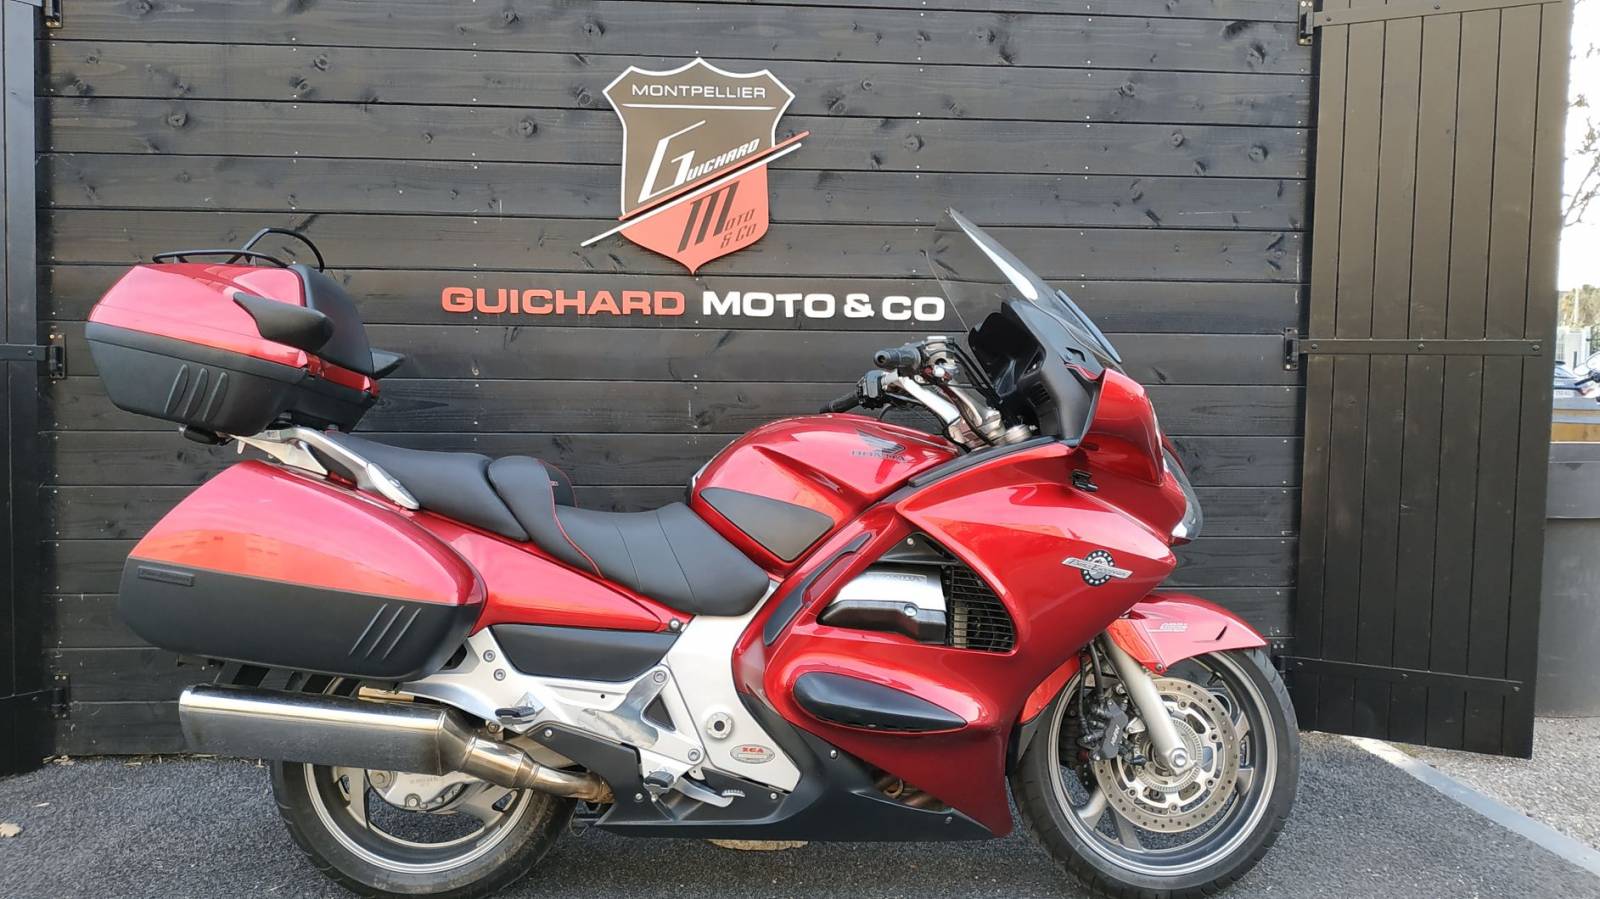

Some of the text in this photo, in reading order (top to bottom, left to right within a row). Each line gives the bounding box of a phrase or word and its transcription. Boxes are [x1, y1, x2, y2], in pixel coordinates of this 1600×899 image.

[632, 84, 766, 99] MONTPELLIER
[638, 120, 760, 204] GUICHARD
[441, 287, 946, 322] GUICHARD MOTO & CO
